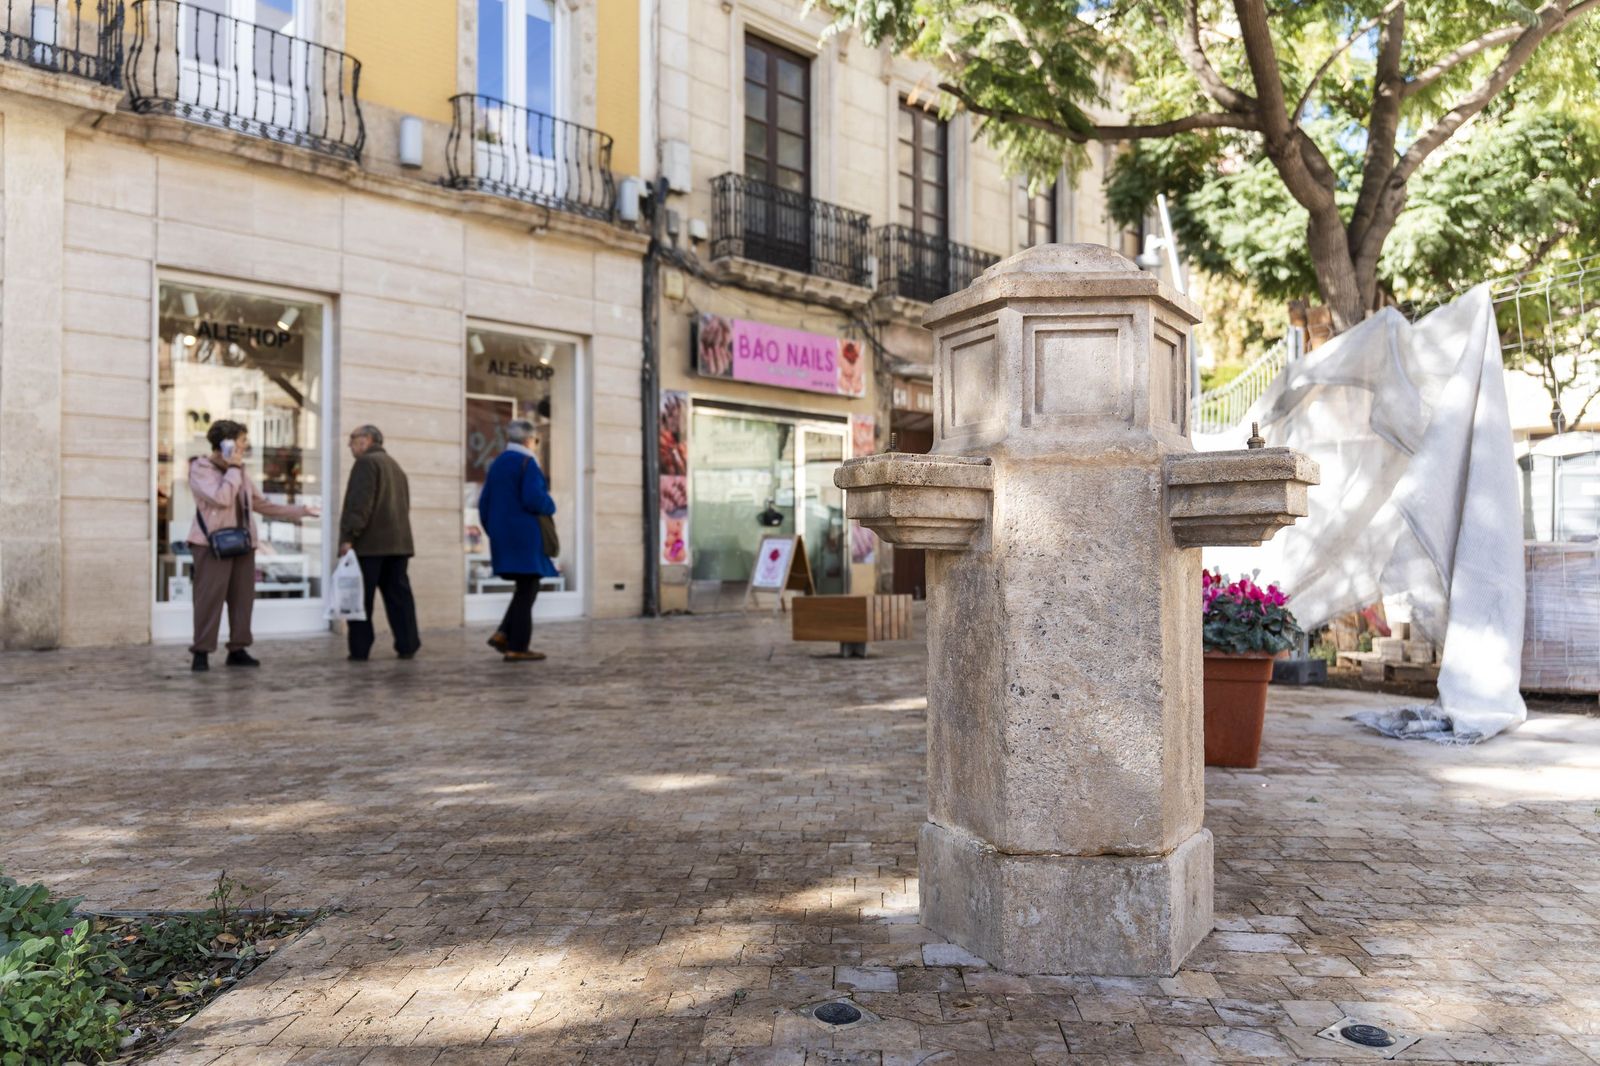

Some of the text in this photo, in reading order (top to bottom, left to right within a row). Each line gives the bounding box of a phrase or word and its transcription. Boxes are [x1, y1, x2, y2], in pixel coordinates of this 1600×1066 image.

[197, 321, 291, 350] ALE-HOP
[739, 335, 834, 372] BAO NAILS
[487, 359, 554, 382] ALE-HOP
